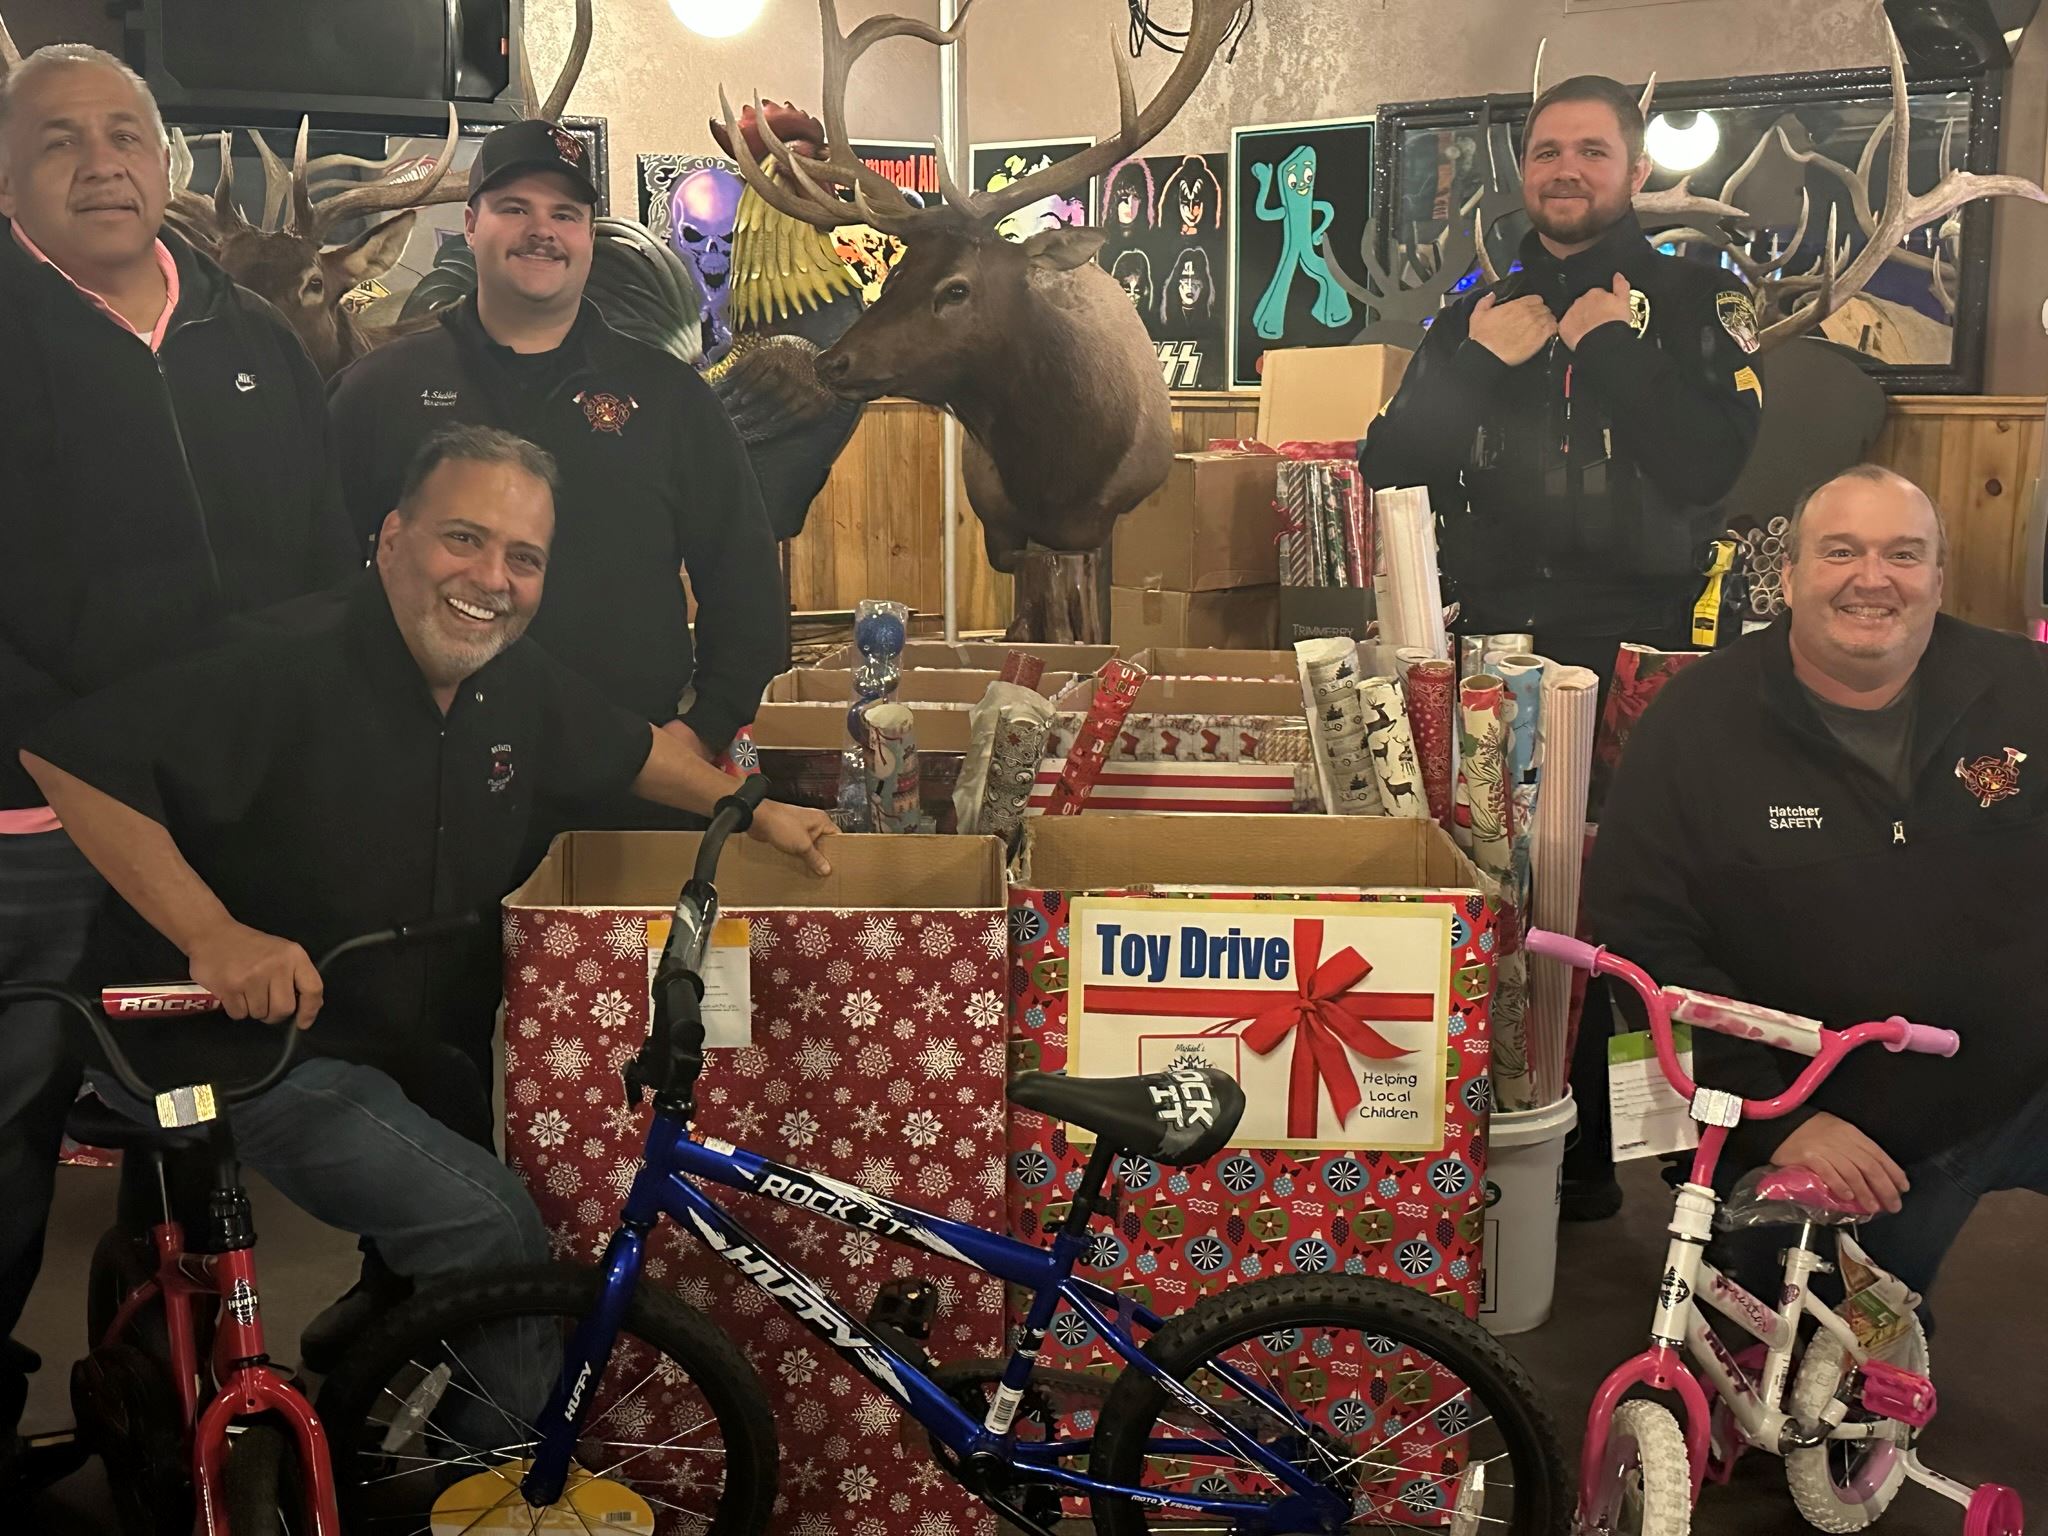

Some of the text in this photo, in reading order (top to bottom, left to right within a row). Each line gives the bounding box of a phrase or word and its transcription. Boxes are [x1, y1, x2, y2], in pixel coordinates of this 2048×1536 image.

[918, 154, 940, 193] Ali
[1769, 805, 1820, 817] Hatcher
[1769, 816, 1823, 829] SAFETY
[1096, 923, 1291, 983] Toy Drive
[120, 998, 207, 1011] ROCK
[1363, 1071, 1418, 1088] Helping
[1148, 1084, 1184, 1128] IT
[1172, 1070, 1214, 1127] OCK
[1369, 1090, 1411, 1102] Local
[1359, 1106, 1419, 1120] Children
[758, 1174, 910, 1235] ROCK IT
[720, 1244, 873, 1348] HUFFY
[564, 1360, 592, 1422] HUFFY
[1157, 1497, 1171, 1507] X
